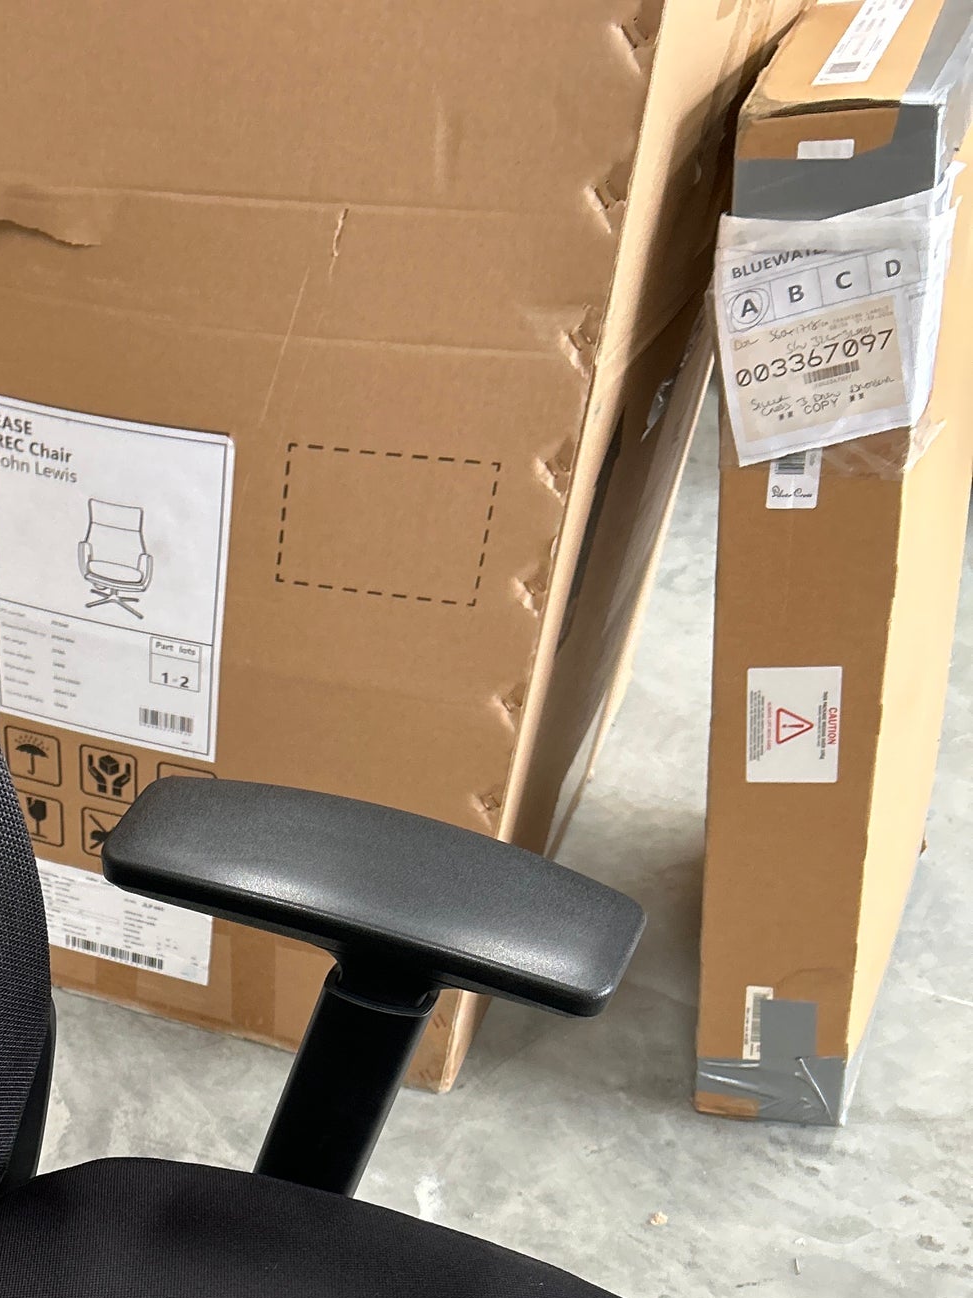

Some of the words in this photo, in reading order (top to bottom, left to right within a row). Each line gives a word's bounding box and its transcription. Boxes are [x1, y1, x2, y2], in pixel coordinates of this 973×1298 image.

[731, 248, 827, 279] BLUEWA
[740, 298, 759, 318] A
[788, 284, 805, 304] B
[836, 271, 852, 290] C
[885, 259, 902, 278] D
[736, 328, 894, 387] 003367097
[804, 398, 838, 415] COPY
[29, 441, 73, 463] Chair
[35, 461, 77, 483] Lewis
[827, 707, 838, 745] CAUTION
